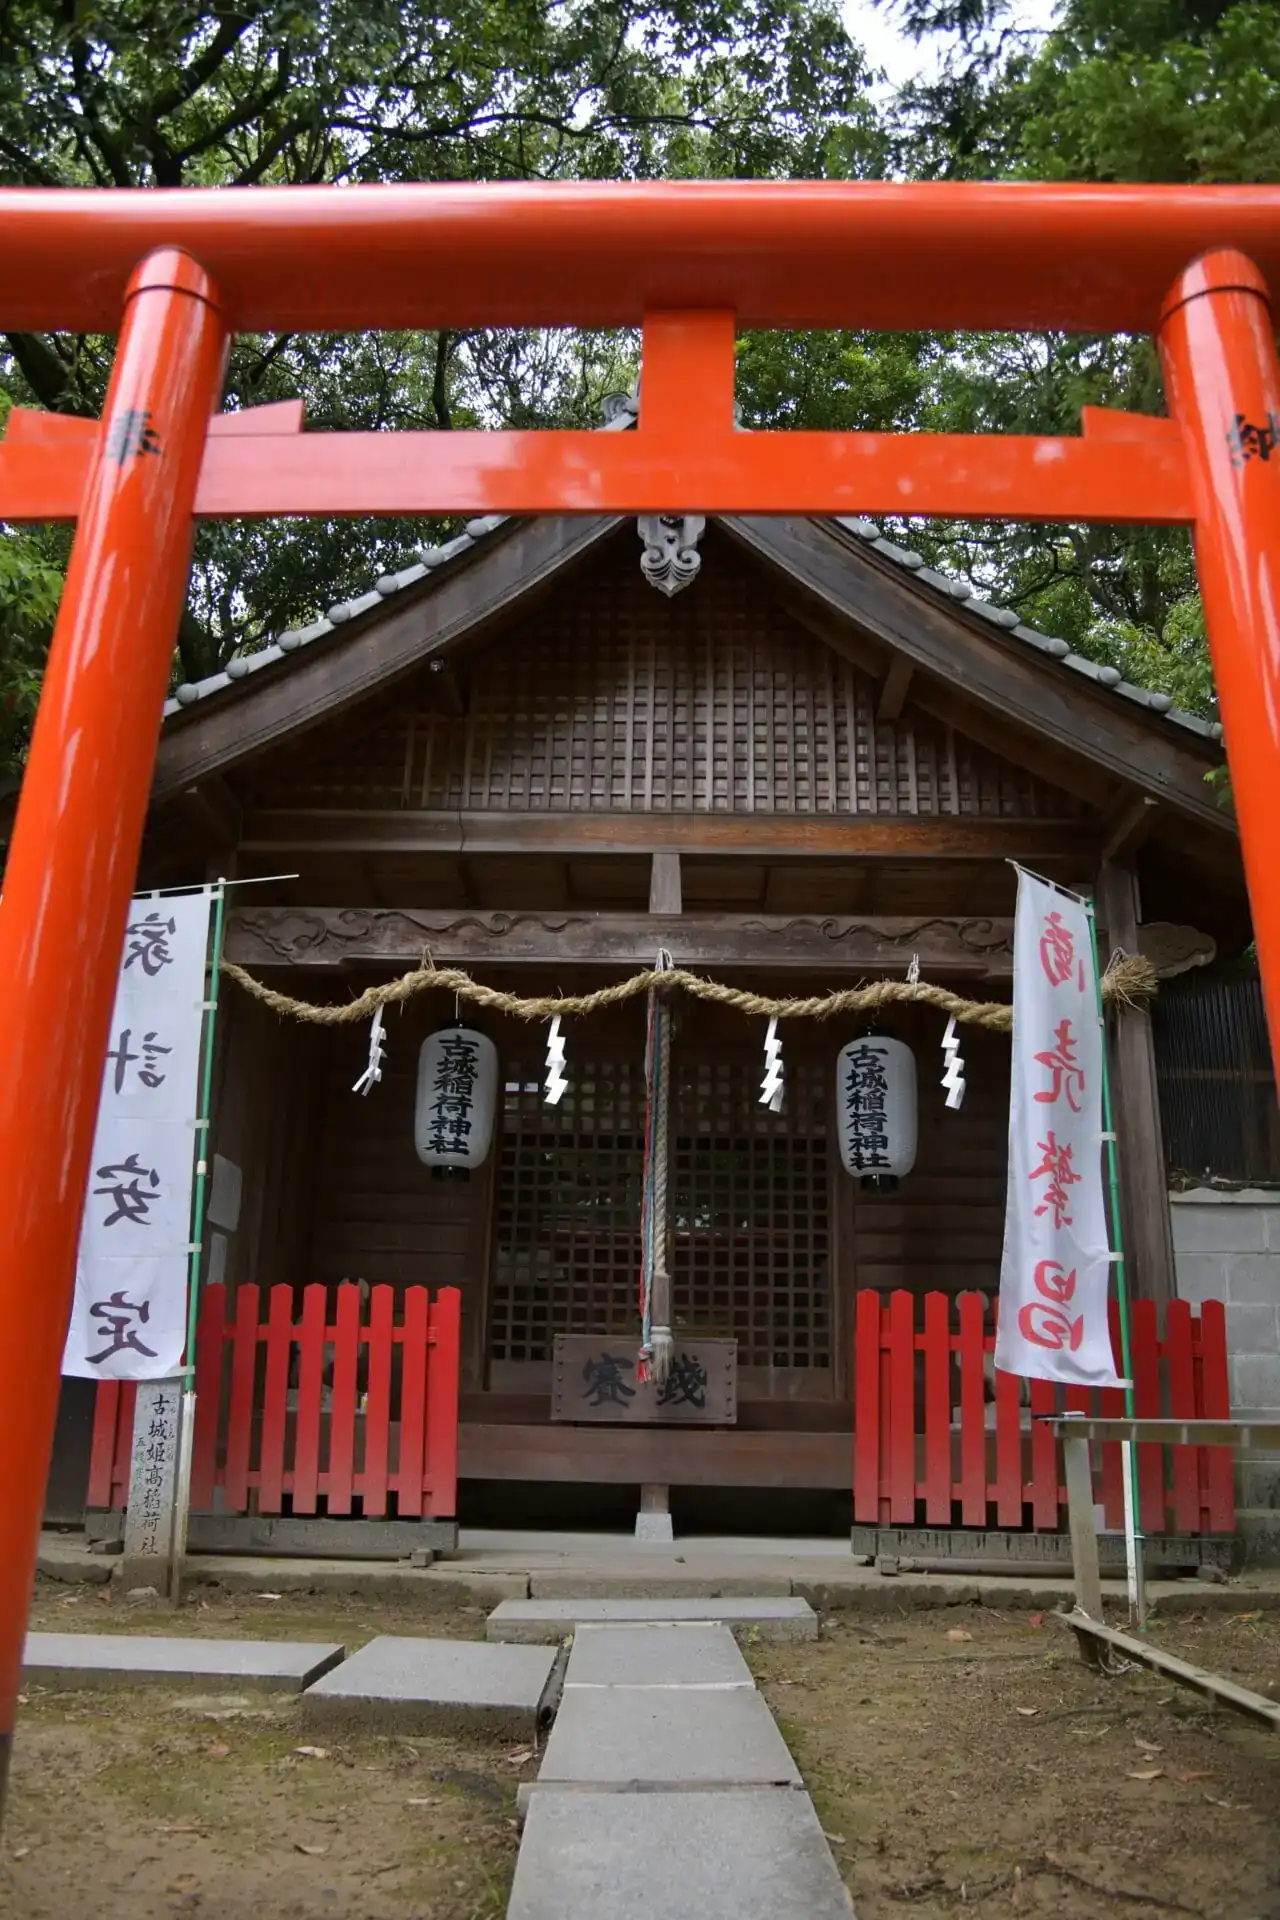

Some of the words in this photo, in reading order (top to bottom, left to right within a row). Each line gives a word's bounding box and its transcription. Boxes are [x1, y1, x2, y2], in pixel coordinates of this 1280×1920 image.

[424, 1034, 480, 1156] 古城稲荷神社
[845, 1044, 892, 1170] 古城稲荷神社
